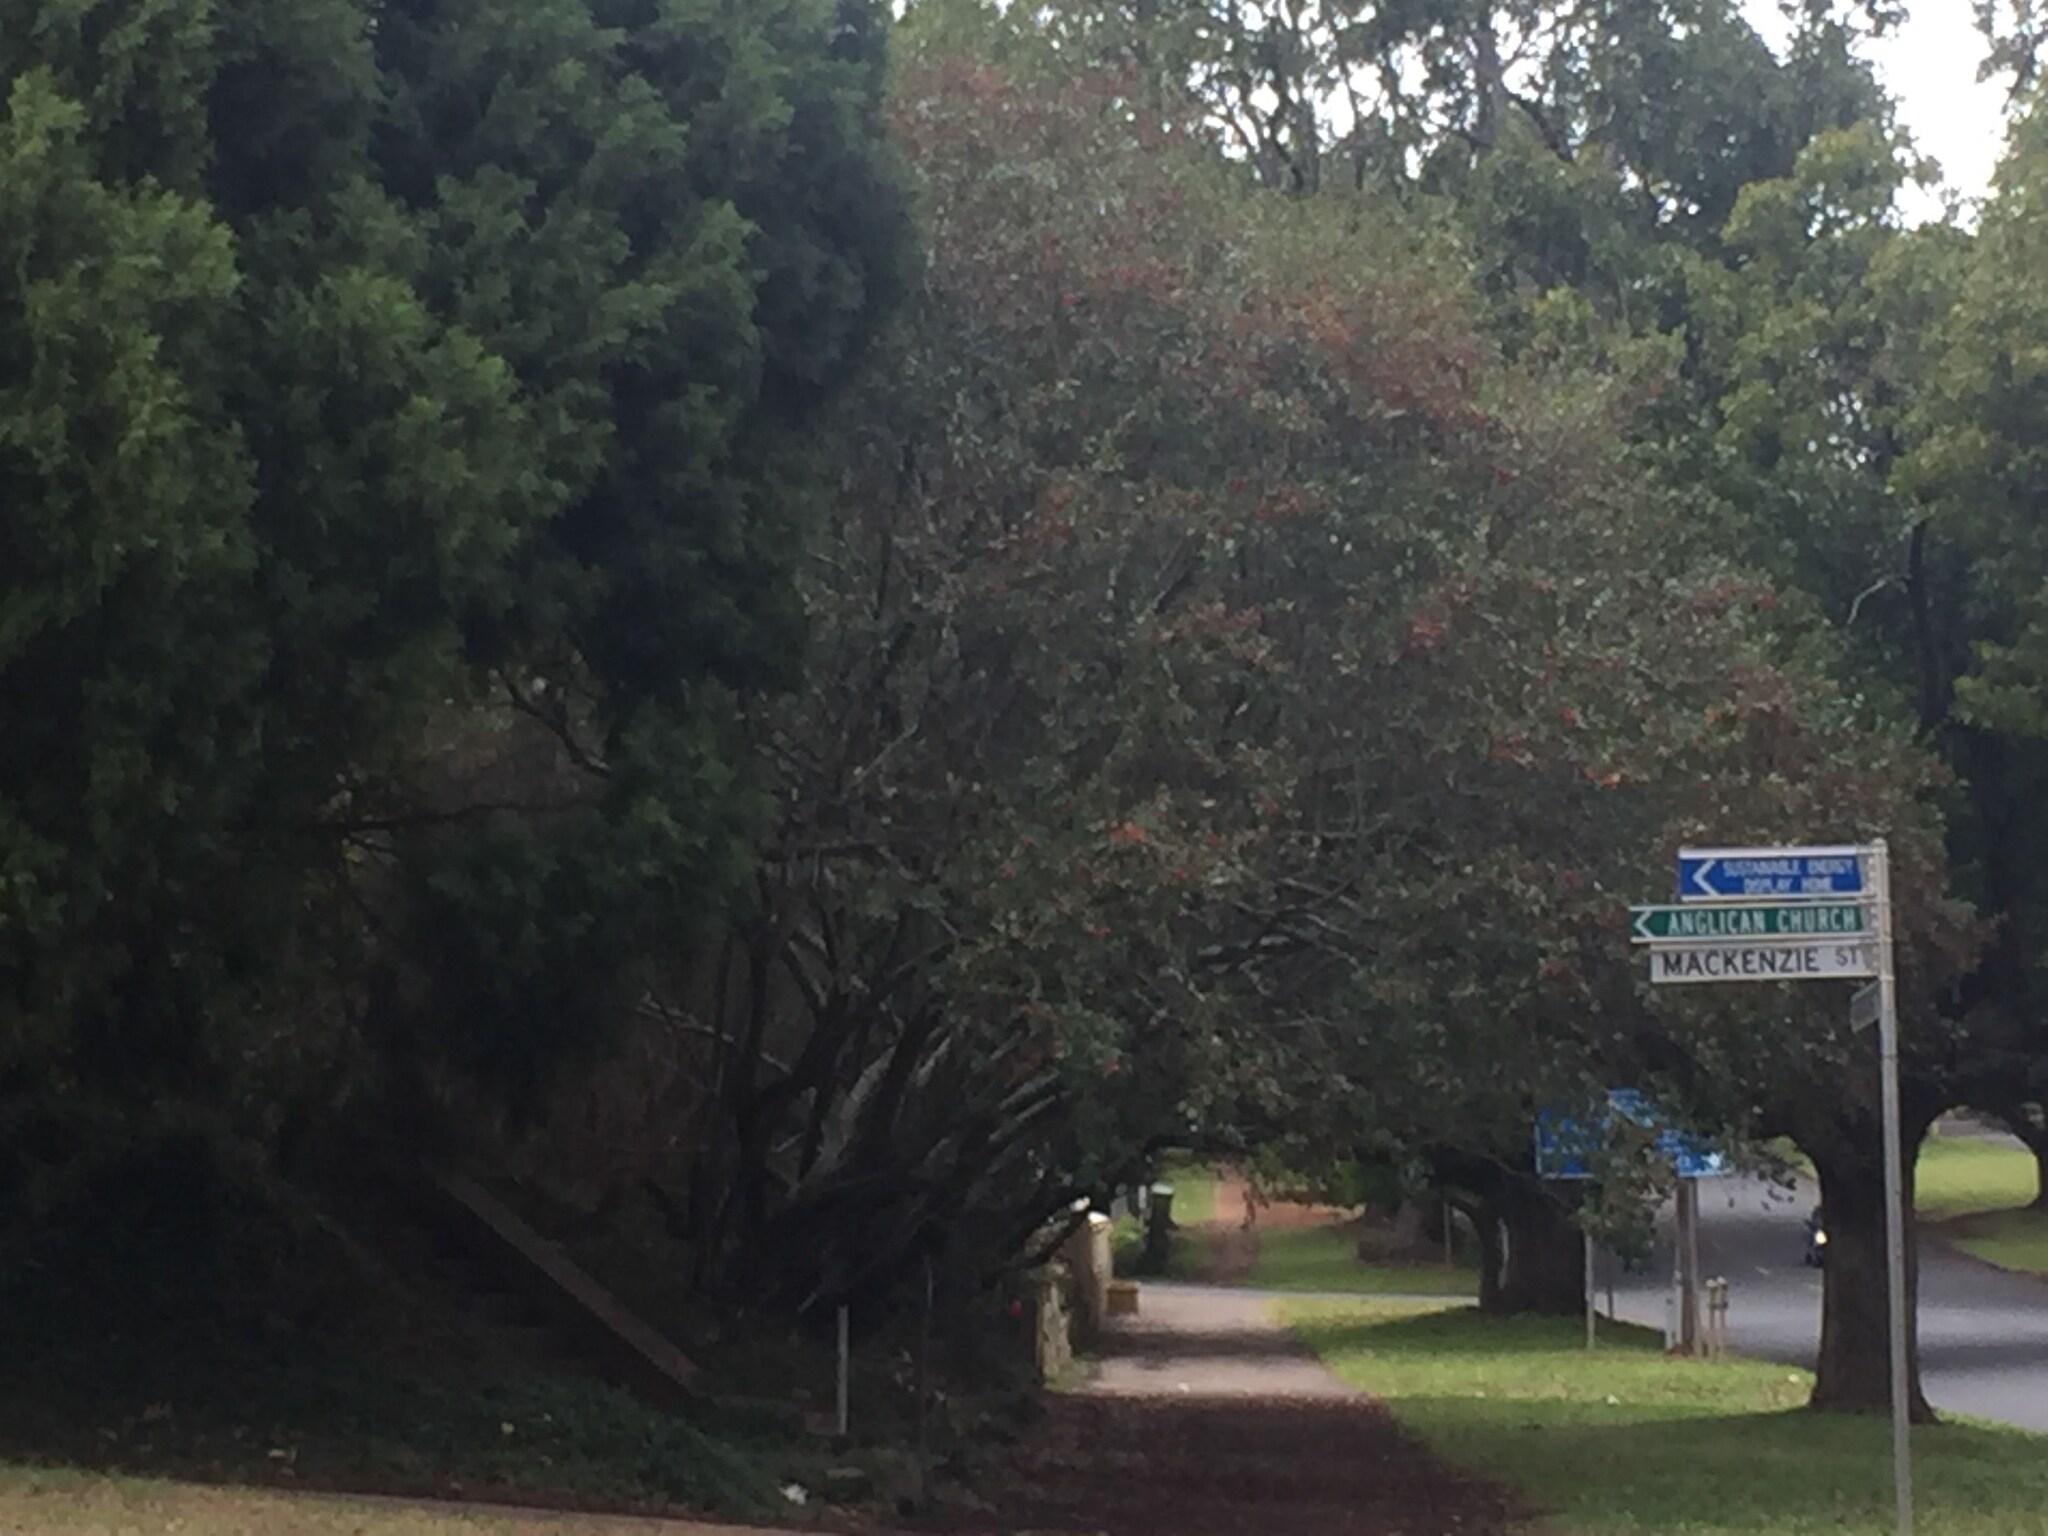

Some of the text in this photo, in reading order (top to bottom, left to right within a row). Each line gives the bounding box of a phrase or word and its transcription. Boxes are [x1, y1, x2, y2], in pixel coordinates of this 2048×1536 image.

[1667, 908, 1857, 935] ANGLICAN CHURCH
[1662, 947, 1859, 976] MACKENZIE ST
